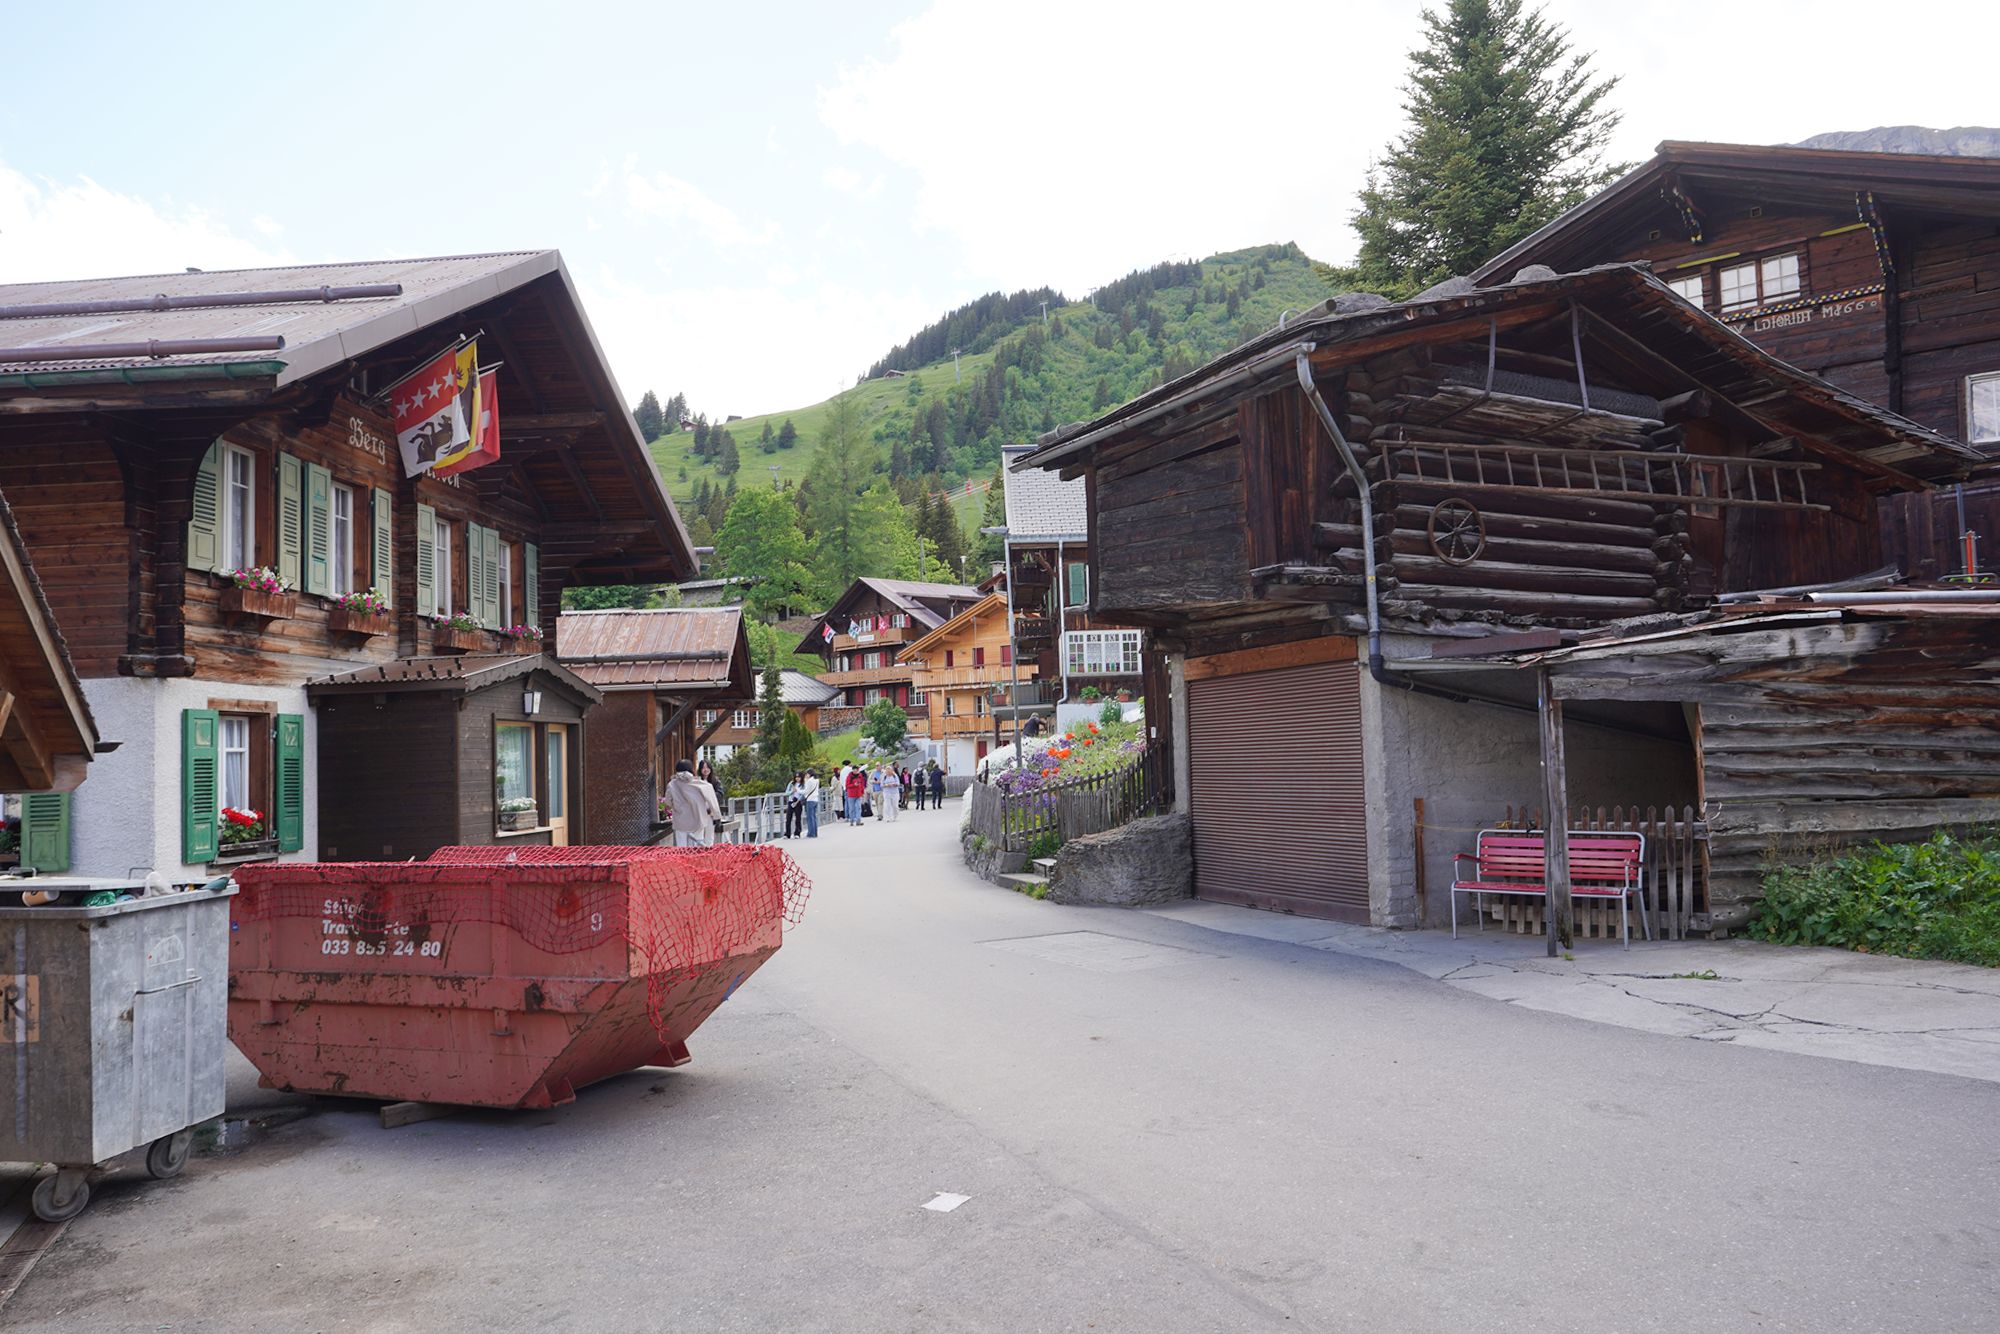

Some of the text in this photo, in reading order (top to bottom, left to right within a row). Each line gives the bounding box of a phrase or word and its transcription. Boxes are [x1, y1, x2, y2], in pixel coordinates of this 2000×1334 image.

[348, 416, 386, 466] Berg
[321, 939, 350, 955] 033
[393, 940, 415, 956] 24
[420, 940, 442, 957] 80
